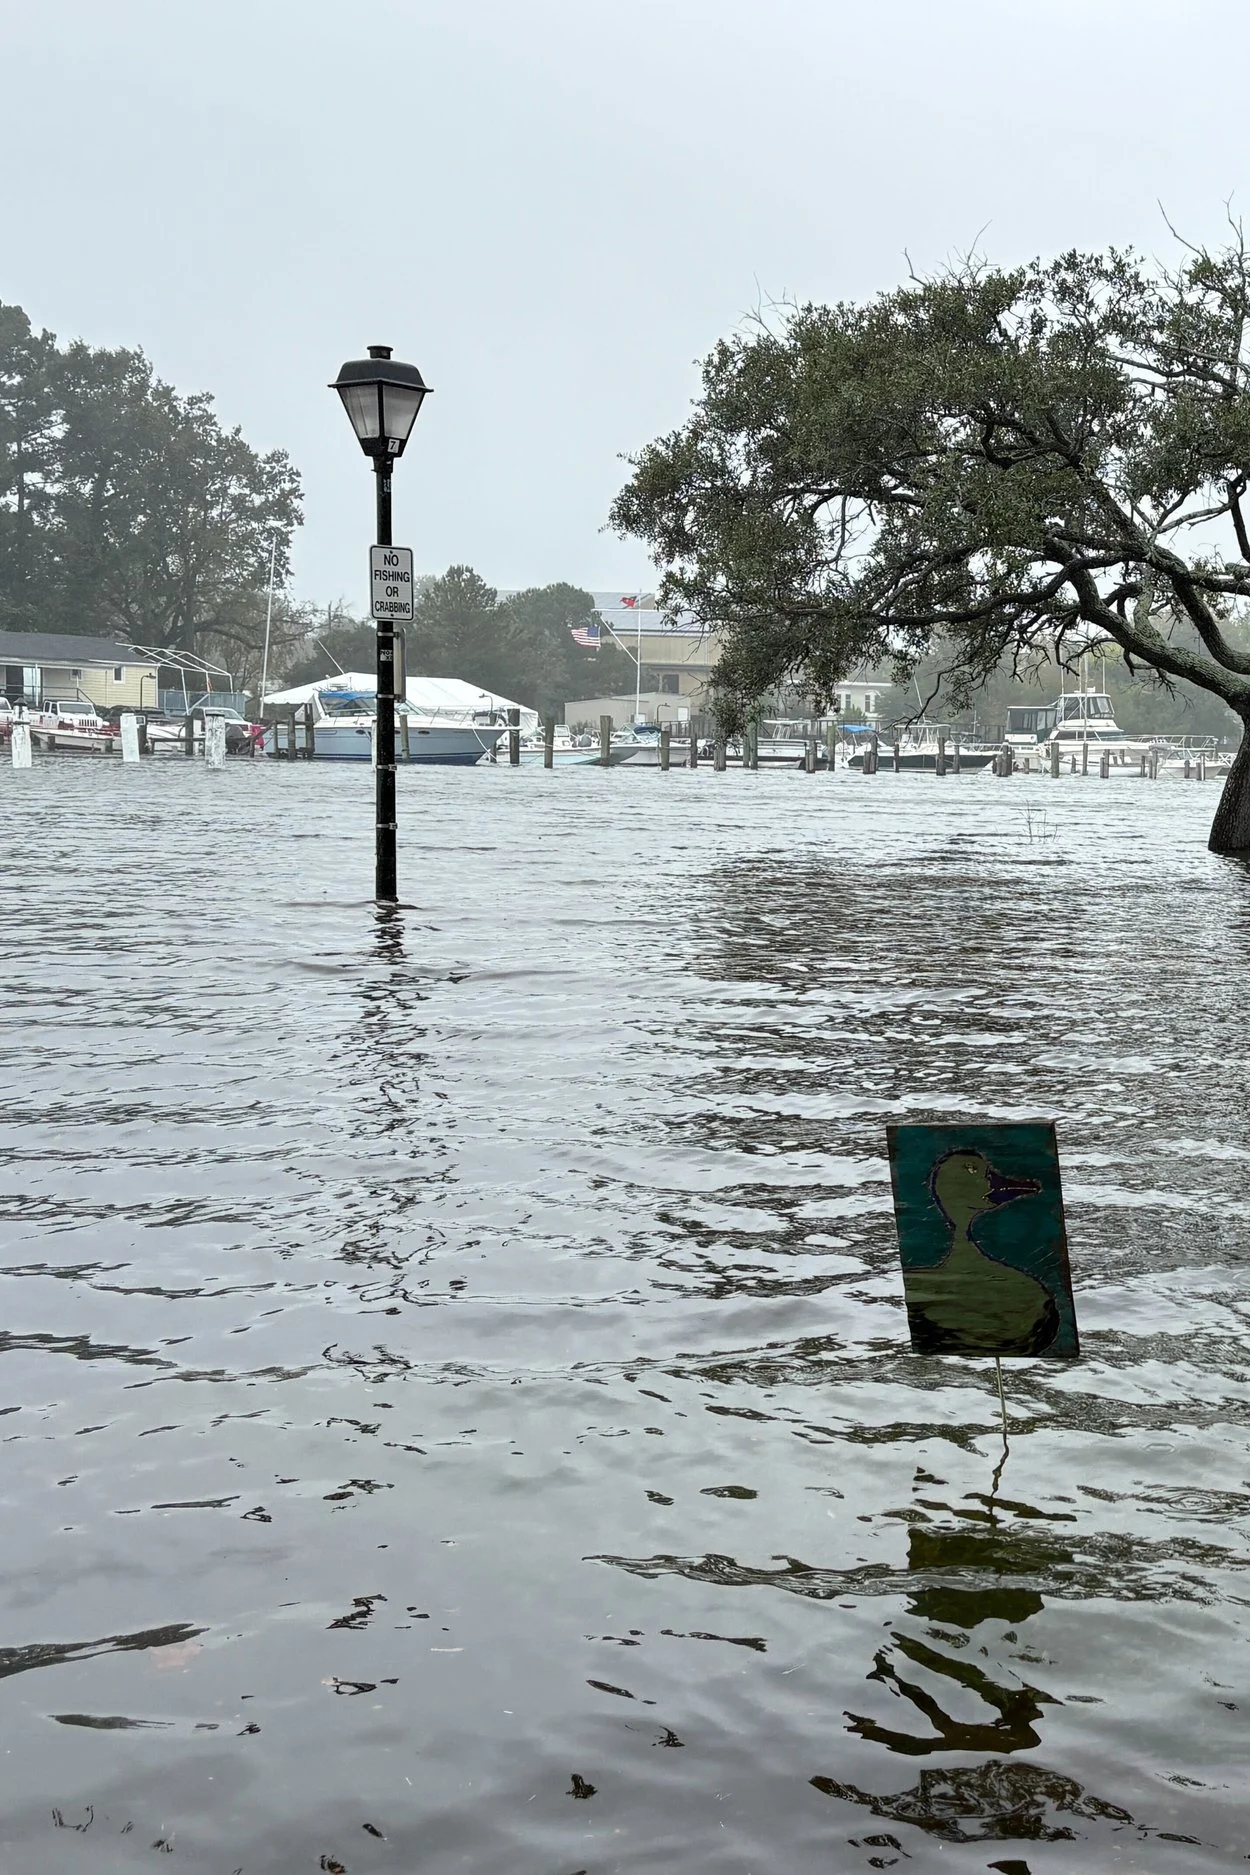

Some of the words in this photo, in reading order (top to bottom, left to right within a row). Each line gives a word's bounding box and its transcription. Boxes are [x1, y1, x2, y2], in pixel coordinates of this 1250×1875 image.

[390, 441, 396, 449] 7
[384, 554, 398, 566] NO
[374, 570, 410, 583] FISHING
[386, 586, 398, 597] OR
[375, 601, 410, 613] CRABBING
